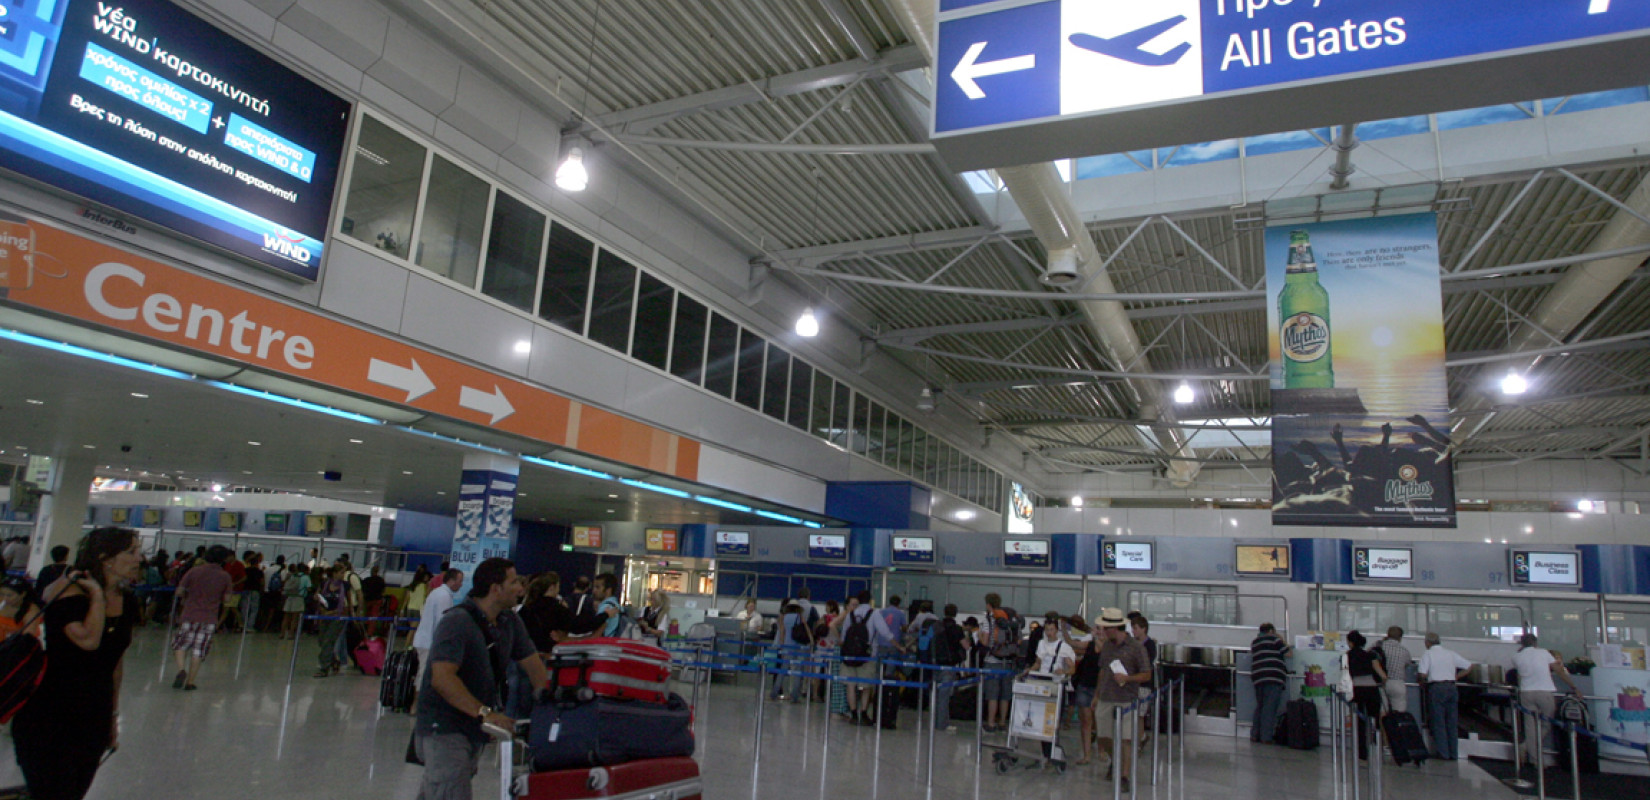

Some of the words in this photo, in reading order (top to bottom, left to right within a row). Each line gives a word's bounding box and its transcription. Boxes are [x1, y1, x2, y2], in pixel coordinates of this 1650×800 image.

[98, 2, 137, 32] νέα
[1220, 28, 1271, 71] All
[1287, 16, 1406, 60] Gates
[93, 15, 151, 54] WIND
[153, 47, 271, 117] καρτοκινητή
[198, 102, 210, 116] 2
[256, 144, 289, 169] WIND
[290, 162, 300, 174] &
[0, 231, 29, 251] ing
[263, 233, 311, 263] WIND
[84, 262, 316, 371] Centre
[1284, 326, 1327, 350] Mythos
[1384, 479, 1434, 504] Mythos
[451, 551, 477, 564] BLUE
[482, 548, 508, 560] BLUE
[1121, 550, 1143, 558] Special
[1377, 557, 1408, 565] Baggage
[1535, 561, 1569, 569] Business
[1421, 570, 1435, 581] 98
[1488, 571, 1504, 584] 97
